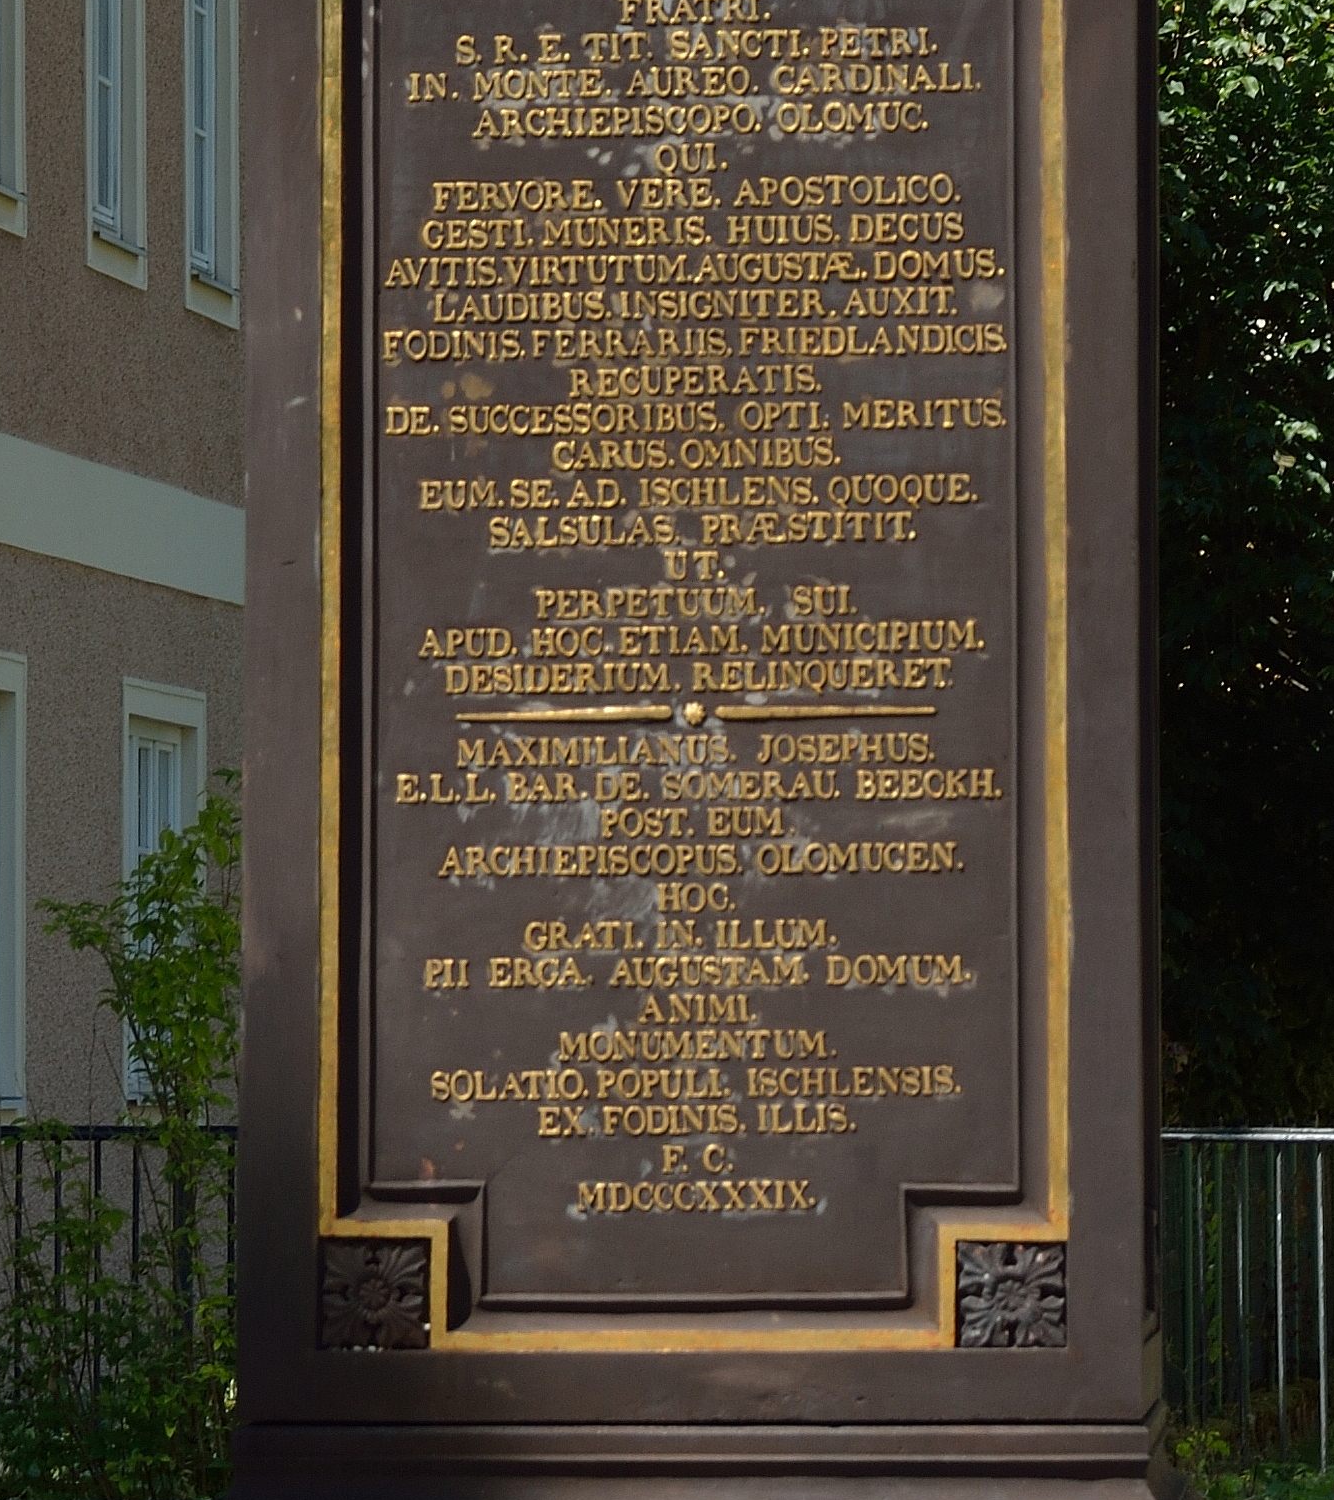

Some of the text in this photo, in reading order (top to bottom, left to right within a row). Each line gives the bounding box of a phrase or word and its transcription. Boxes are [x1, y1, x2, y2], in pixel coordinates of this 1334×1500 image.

[455, 33, 482, 66] S.
[494, 33, 529, 65] R.
[537, 33, 572, 65] E.
[667, 27, 813, 62] SANCTI.
[818, 26, 938, 63] PETRI.
[407, 61, 981, 103] IN. MONTE. AUREO. CARDINALI.
[472, 99, 930, 139] ARCHIEPISCOPO. OLOMUC.
[653, 141, 728, 178] QUI.
[431, 171, 962, 213] FERVORE. VERE. APOSTOLICO.
[418, 210, 965, 251] GESTI. MUNERIS. HUIUS. DECUS
[872, 246, 1007, 282] DOMUS.
[432, 284, 959, 325] LAUDIBUS. INSIGNITER. AUXIT.
[381, 322, 1009, 364] FODINIS. FERRARIIS. FRIEDLANDICIS.
[567, 364, 823, 399] RECUPERATIS.
[384, 396, 1008, 438] DE. SUCCESSORIBUS. OPTI. MERITUS.
[551, 434, 843, 473] CARUS. OMNIBUS.
[419, 472, 979, 514] EUM. SE. AD. ISCHLENS. QUOQUE.
[488, 512, 683, 549] SALSULAS.
[662, 548, 727, 582] UT.
[534, 584, 857, 620] PERPETUUM. SUI.
[418, 618, 986, 659] APUD. HOC. ETIAM. MUNICIPIUM.
[444, 660, 682, 695] DESIDERIUM.
[456, 731, 936, 768] MAXIMILIANUS. JOSEPHUS.
[507, 770, 589, 803] BAR.
[594, 771, 651, 803] DE.
[662, 768, 842, 802] SOMERAU.
[854, 767, 1003, 801] BEECKH.
[599, 805, 795, 839] POST. EUM.
[438, 840, 964, 877] ARCHIEPISCOPUS. OLOMUCEN.
[657, 881, 737, 914] HOC.
[523, 918, 838, 954] GRATI. IN. ILLUM.
[424, 957, 469, 989] PII
[609, 953, 810, 989] AUGUSTAM.
[825, 953, 972, 986] DOMUM.
[637, 992, 758, 1025] ANIMI.
[430, 1064, 962, 1103] SOLATIO. POPULI. ISCHLENSIS.
[602, 1102, 747, 1136] FODINIS.
[757, 1102, 856, 1135] ILLIS.
[661, 1142, 734, 1174] F. C.
[577, 1178, 816, 1212] MDCCCXXXIX.
